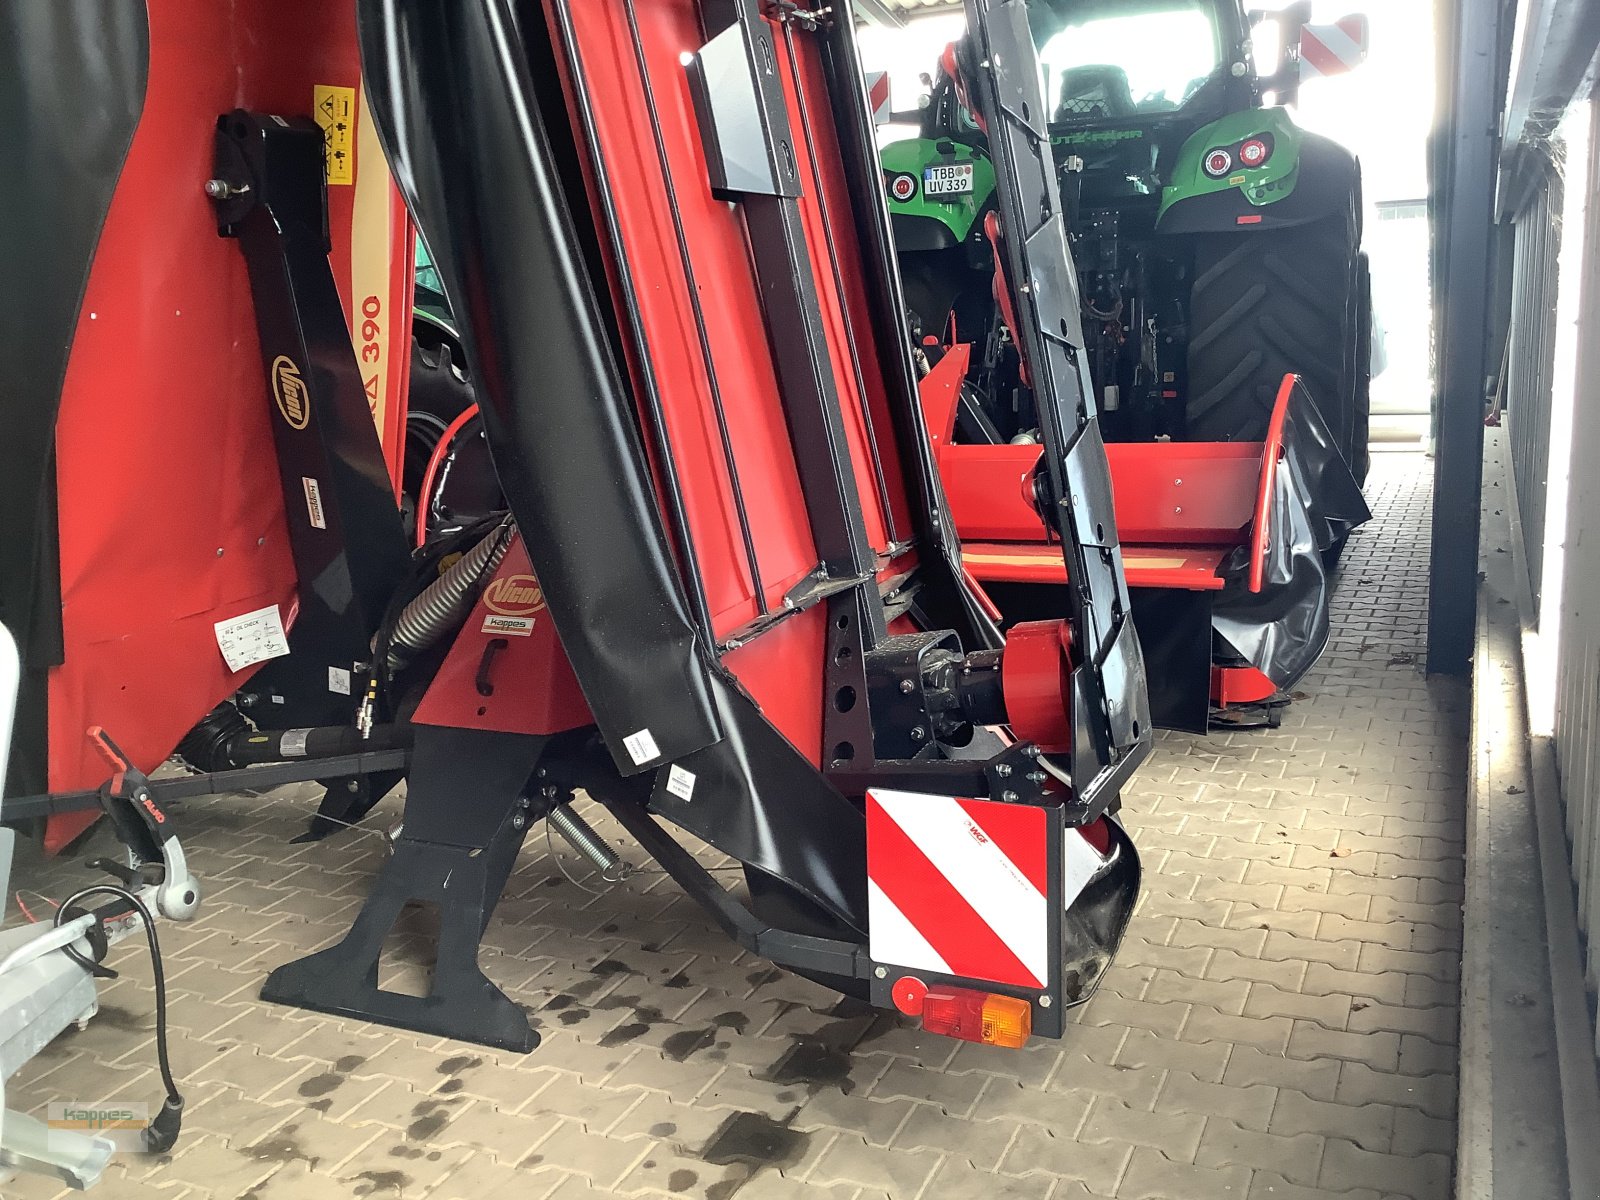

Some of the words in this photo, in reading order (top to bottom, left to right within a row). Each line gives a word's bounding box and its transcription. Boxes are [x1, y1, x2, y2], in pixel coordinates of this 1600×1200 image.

[932, 167, 955, 180] TBB
[929, 180, 944, 192] UV
[946, 178, 967, 191] 339
[361, 295, 381, 363] 390
